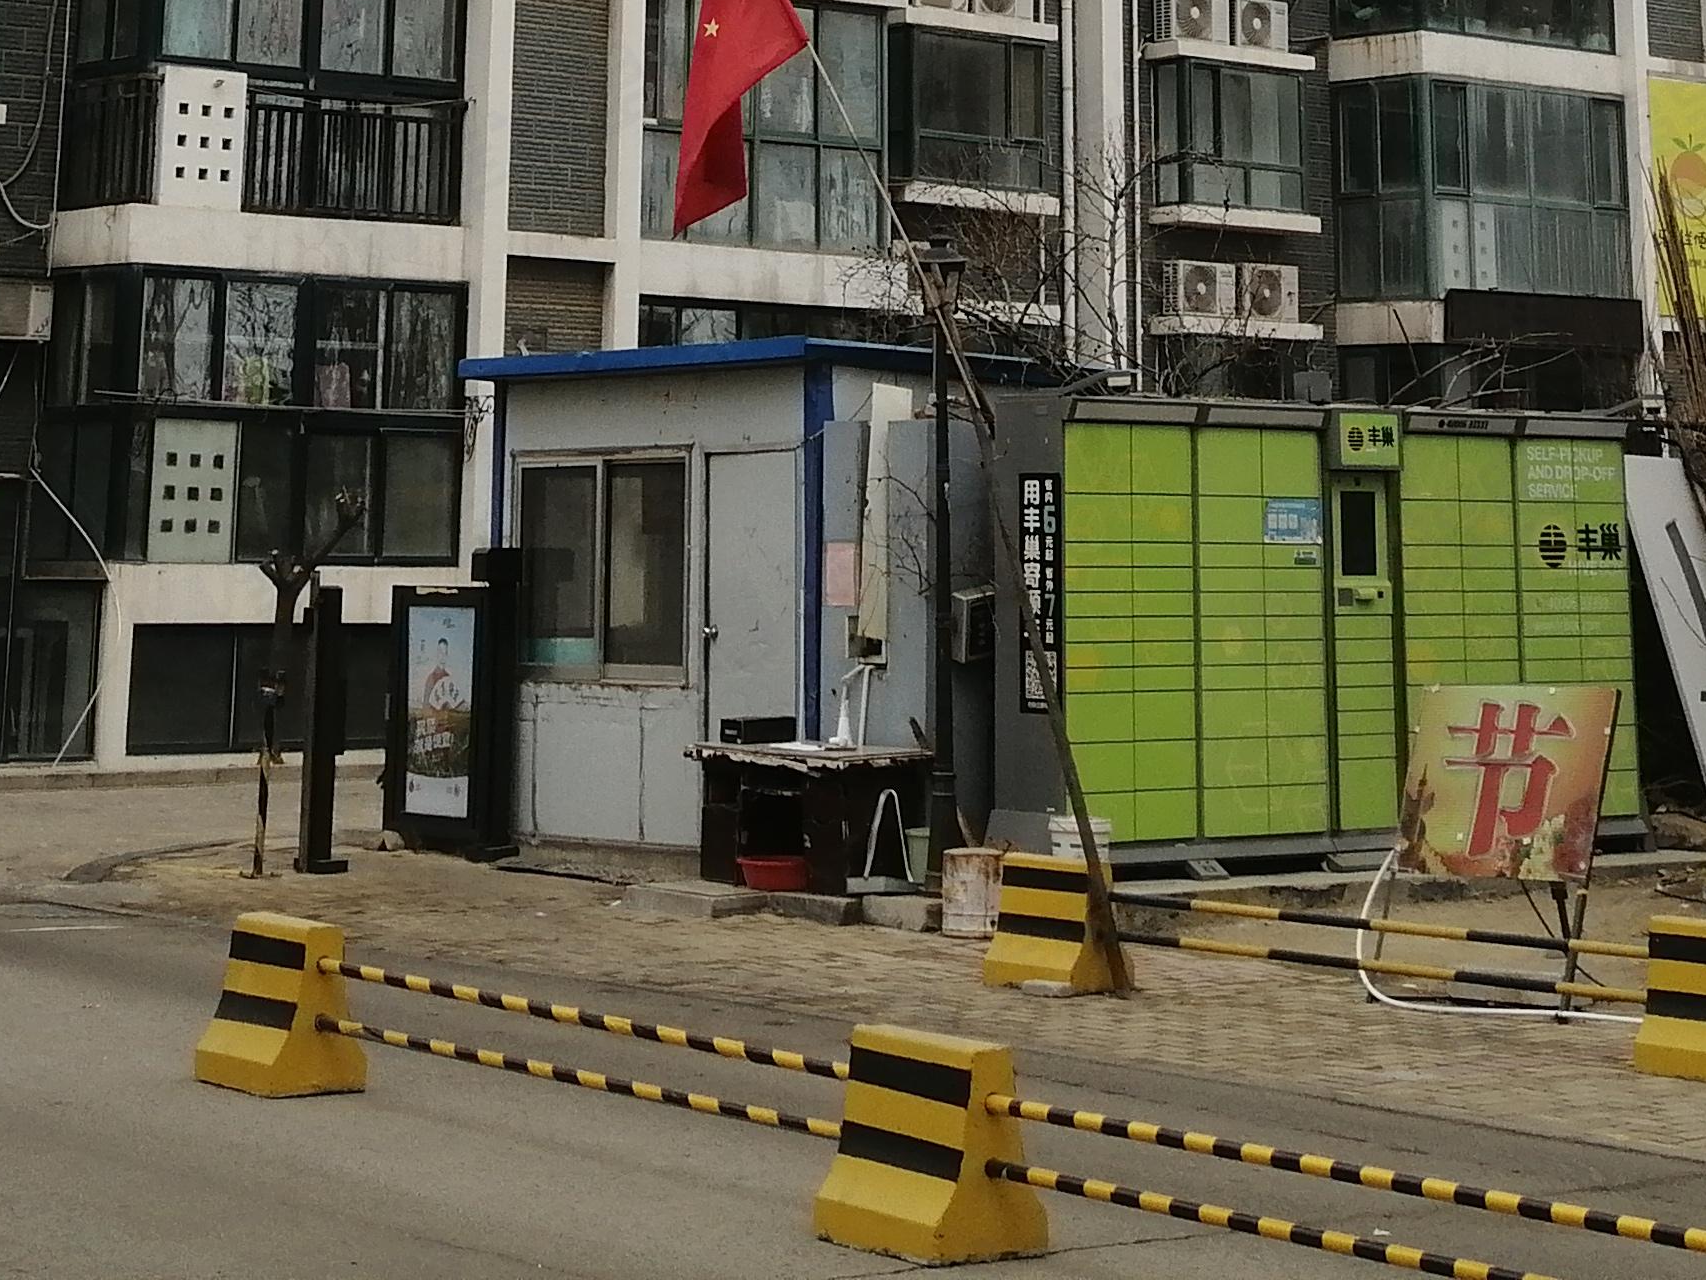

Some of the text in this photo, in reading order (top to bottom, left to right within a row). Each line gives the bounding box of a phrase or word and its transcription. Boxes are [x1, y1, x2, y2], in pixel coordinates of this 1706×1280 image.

[1367, 425, 1394, 447] 丰巢
[1526, 446, 1604, 463] SELF-PICKUP
[1527, 465, 1616, 481] AND DROP-OFF
[1576, 523, 1622, 561] 丰巢
[1443, 700, 1577, 859] 节
